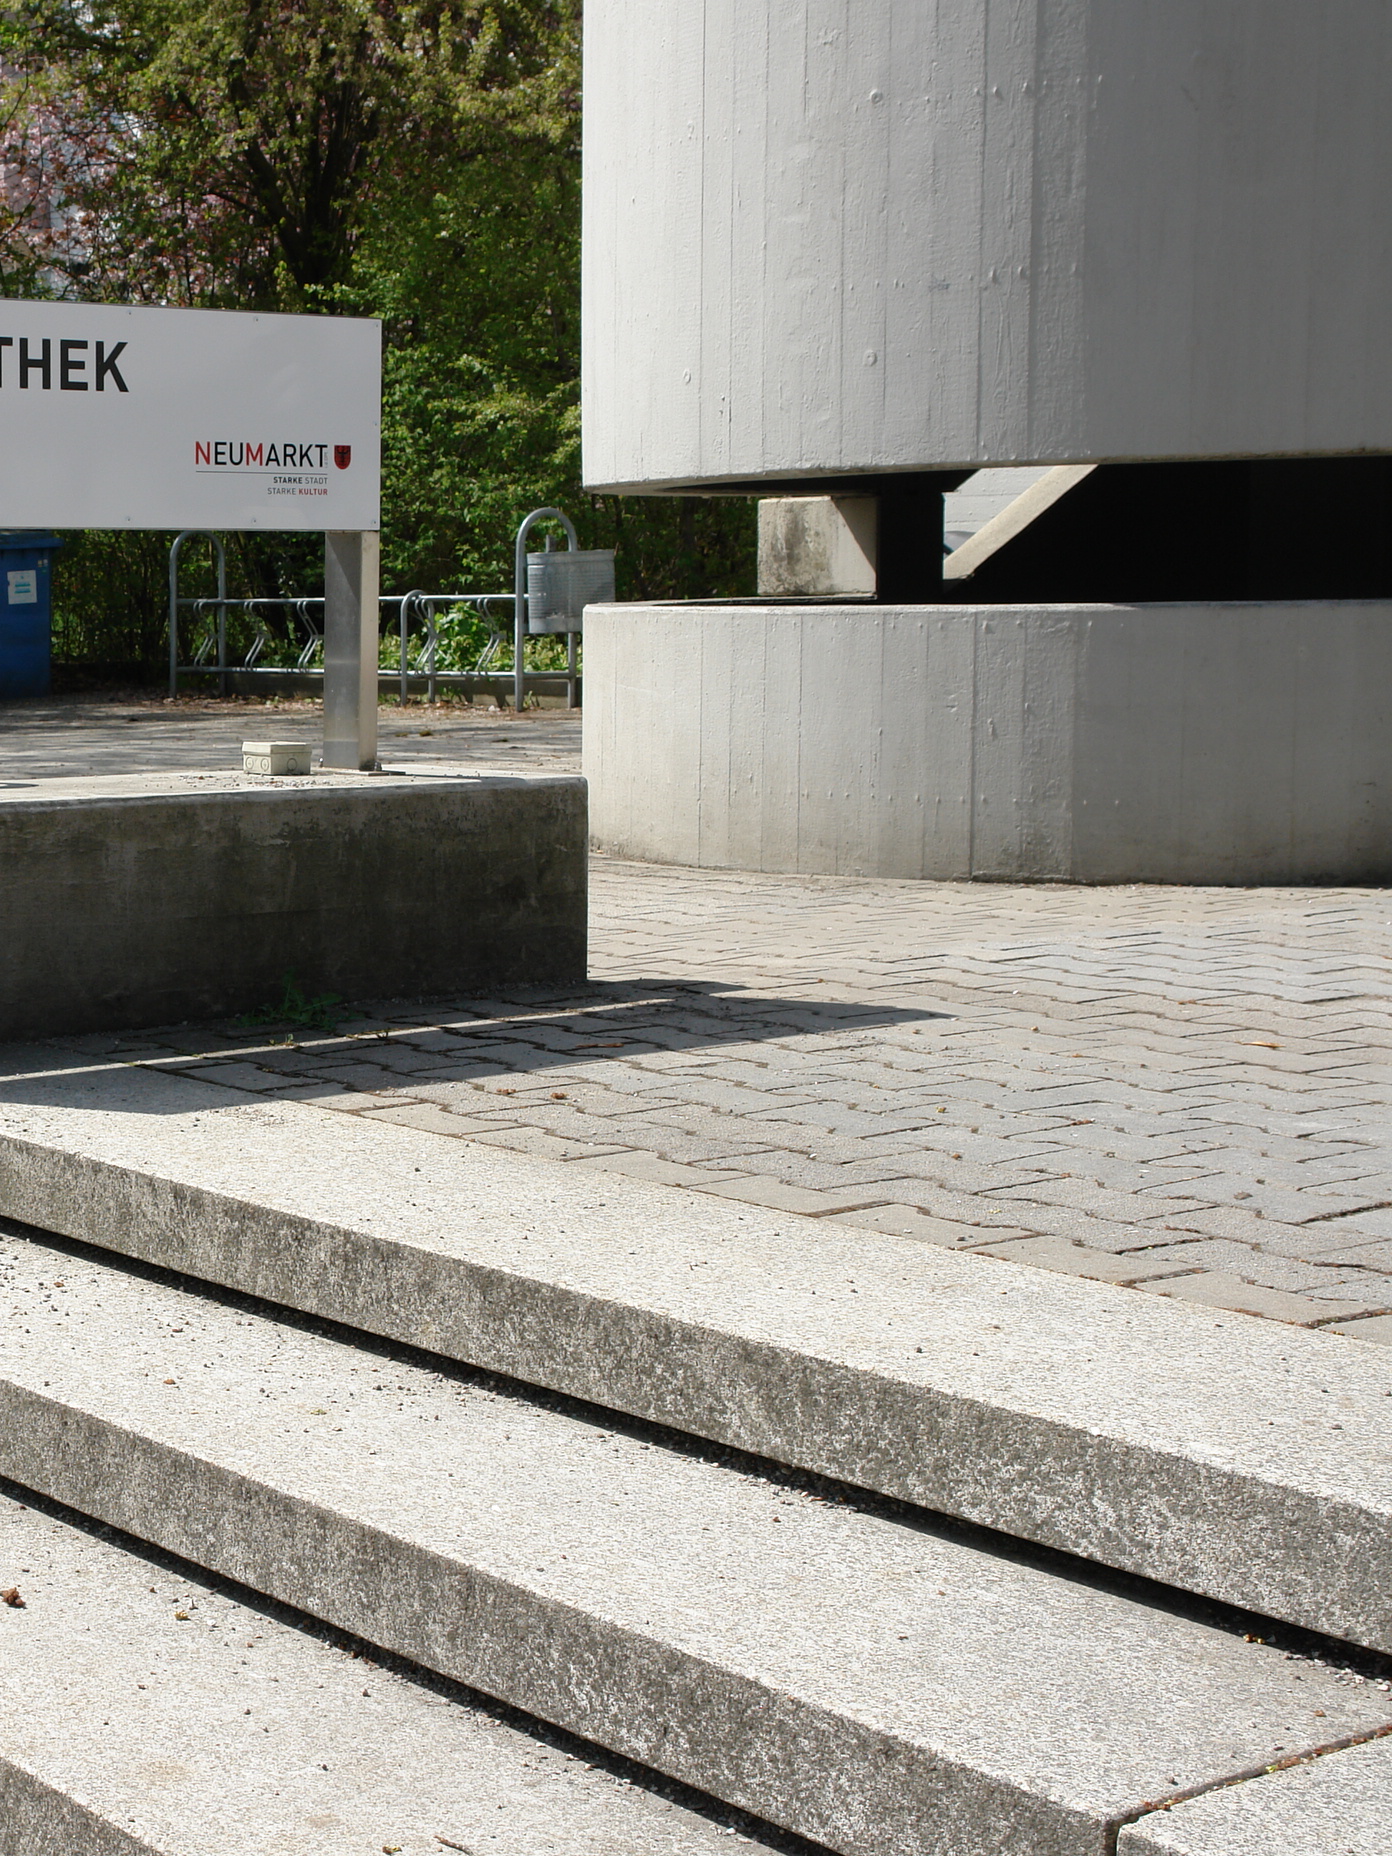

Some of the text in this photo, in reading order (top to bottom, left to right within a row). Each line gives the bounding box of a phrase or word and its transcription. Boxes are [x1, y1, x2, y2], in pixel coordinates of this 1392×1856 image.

[195, 441, 328, 468] NEUMARKT
[273, 476, 328, 485] STARKE STADT
[267, 487, 328, 496] STARKE KULTUR
